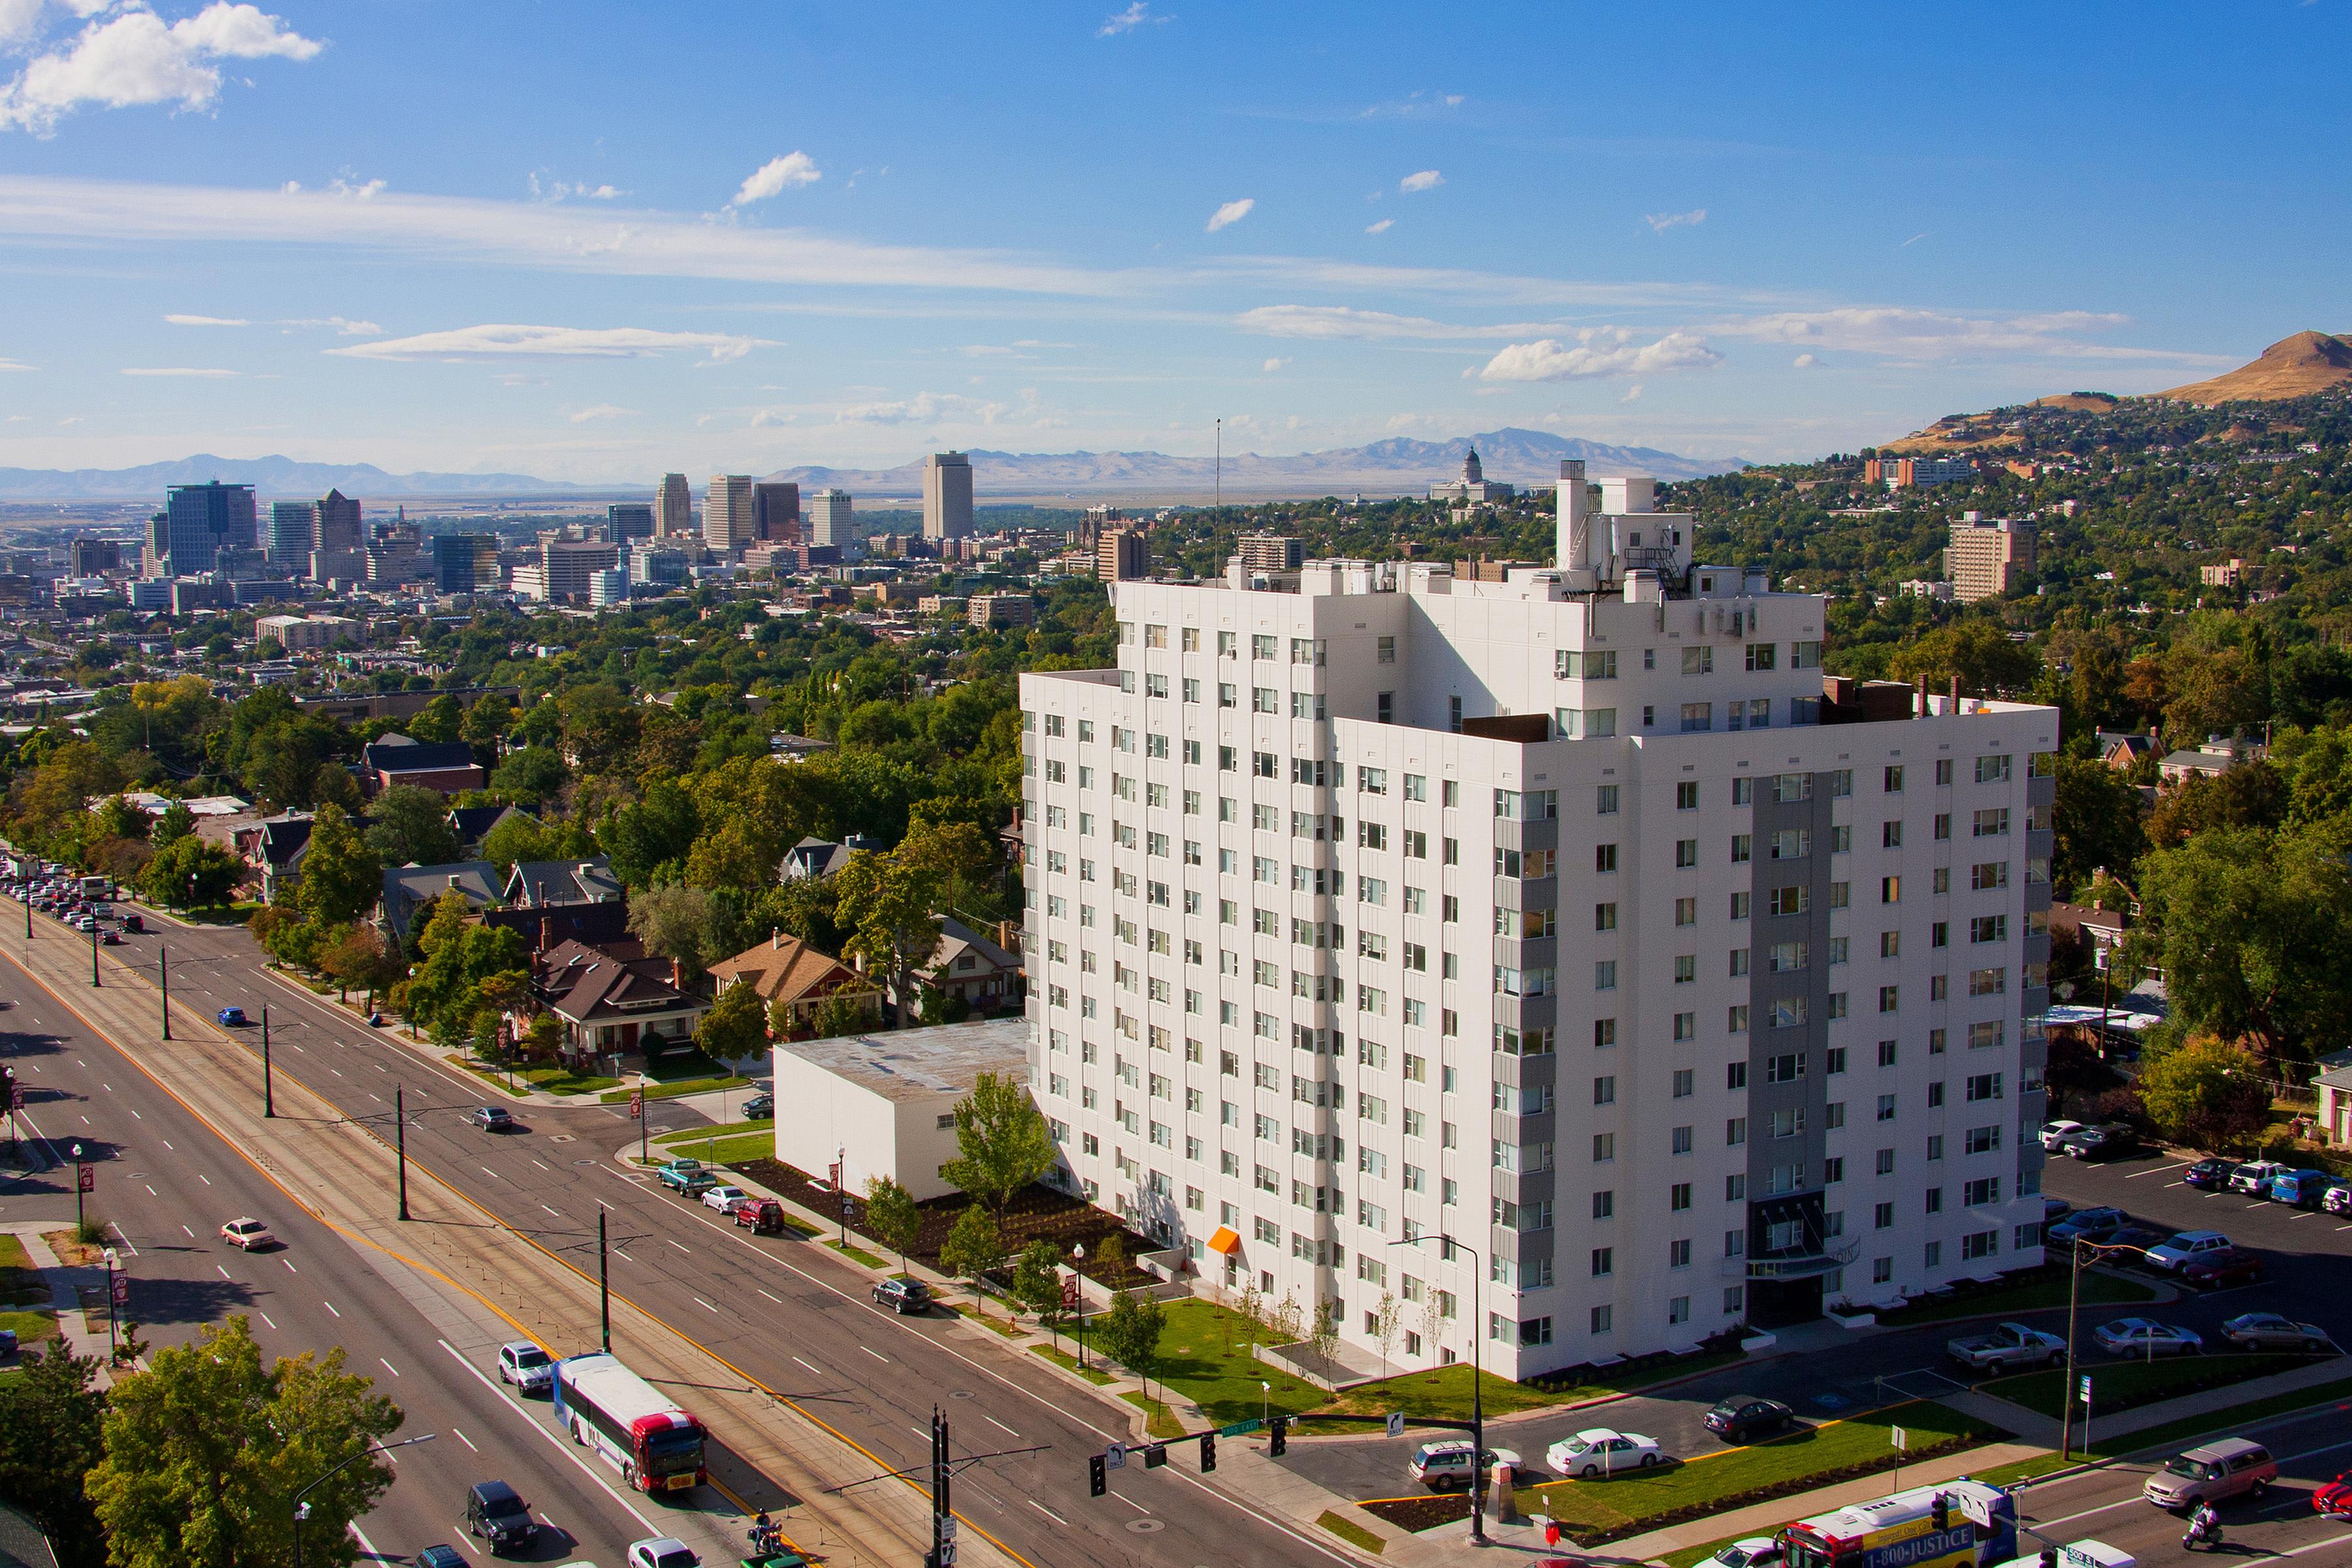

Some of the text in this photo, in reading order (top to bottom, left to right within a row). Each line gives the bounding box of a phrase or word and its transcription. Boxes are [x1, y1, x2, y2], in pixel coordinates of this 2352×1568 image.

[1224, 1421, 1257, 1436] 1300 EAST
[2069, 1548, 2083, 1560] 500
